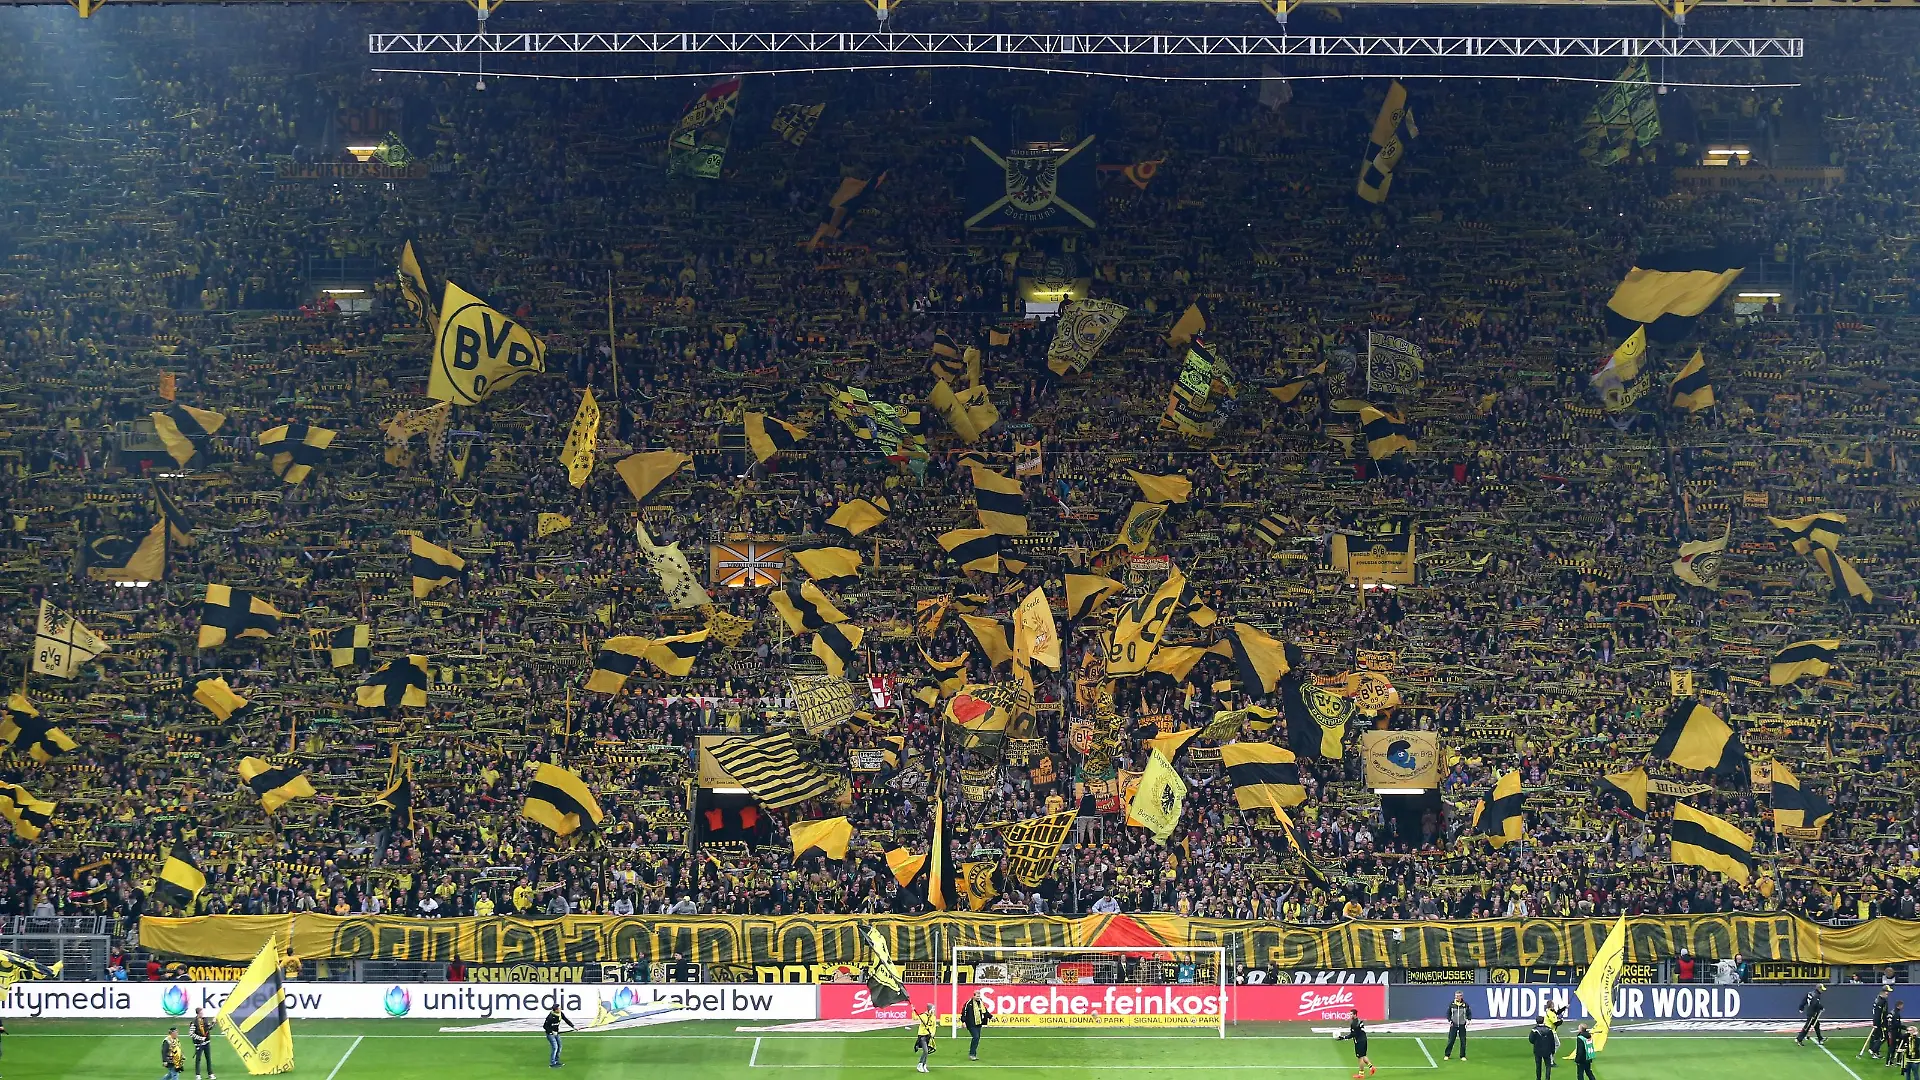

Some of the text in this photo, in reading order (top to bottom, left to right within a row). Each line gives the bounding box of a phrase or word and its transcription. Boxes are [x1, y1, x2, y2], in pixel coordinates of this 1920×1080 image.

[1004, 205, 1057, 222] Dortmund
[473, 374, 488, 396] 0
[1361, 682, 1384, 700] BVB
[538, 966, 585, 982] BECK
[1247, 970, 1390, 984] BRKUM
[1752, 964, 1831, 978] LIPPSTADT
[423, 987, 582, 1018] unitymedia
[653, 988, 773, 1011] kabel bw
[1299, 985, 1354, 1011] Sprehe
[1486, 987, 1569, 1018] WIDEN
[1651, 987, 1741, 1018] WORLD
[875, 1010, 907, 1019] feinkost
[1039, 1016, 1068, 1024] SIGNAL
[1069, 1016, 1094, 1024] IDUNA
[1321, 1011, 1352, 1019] feinkos
